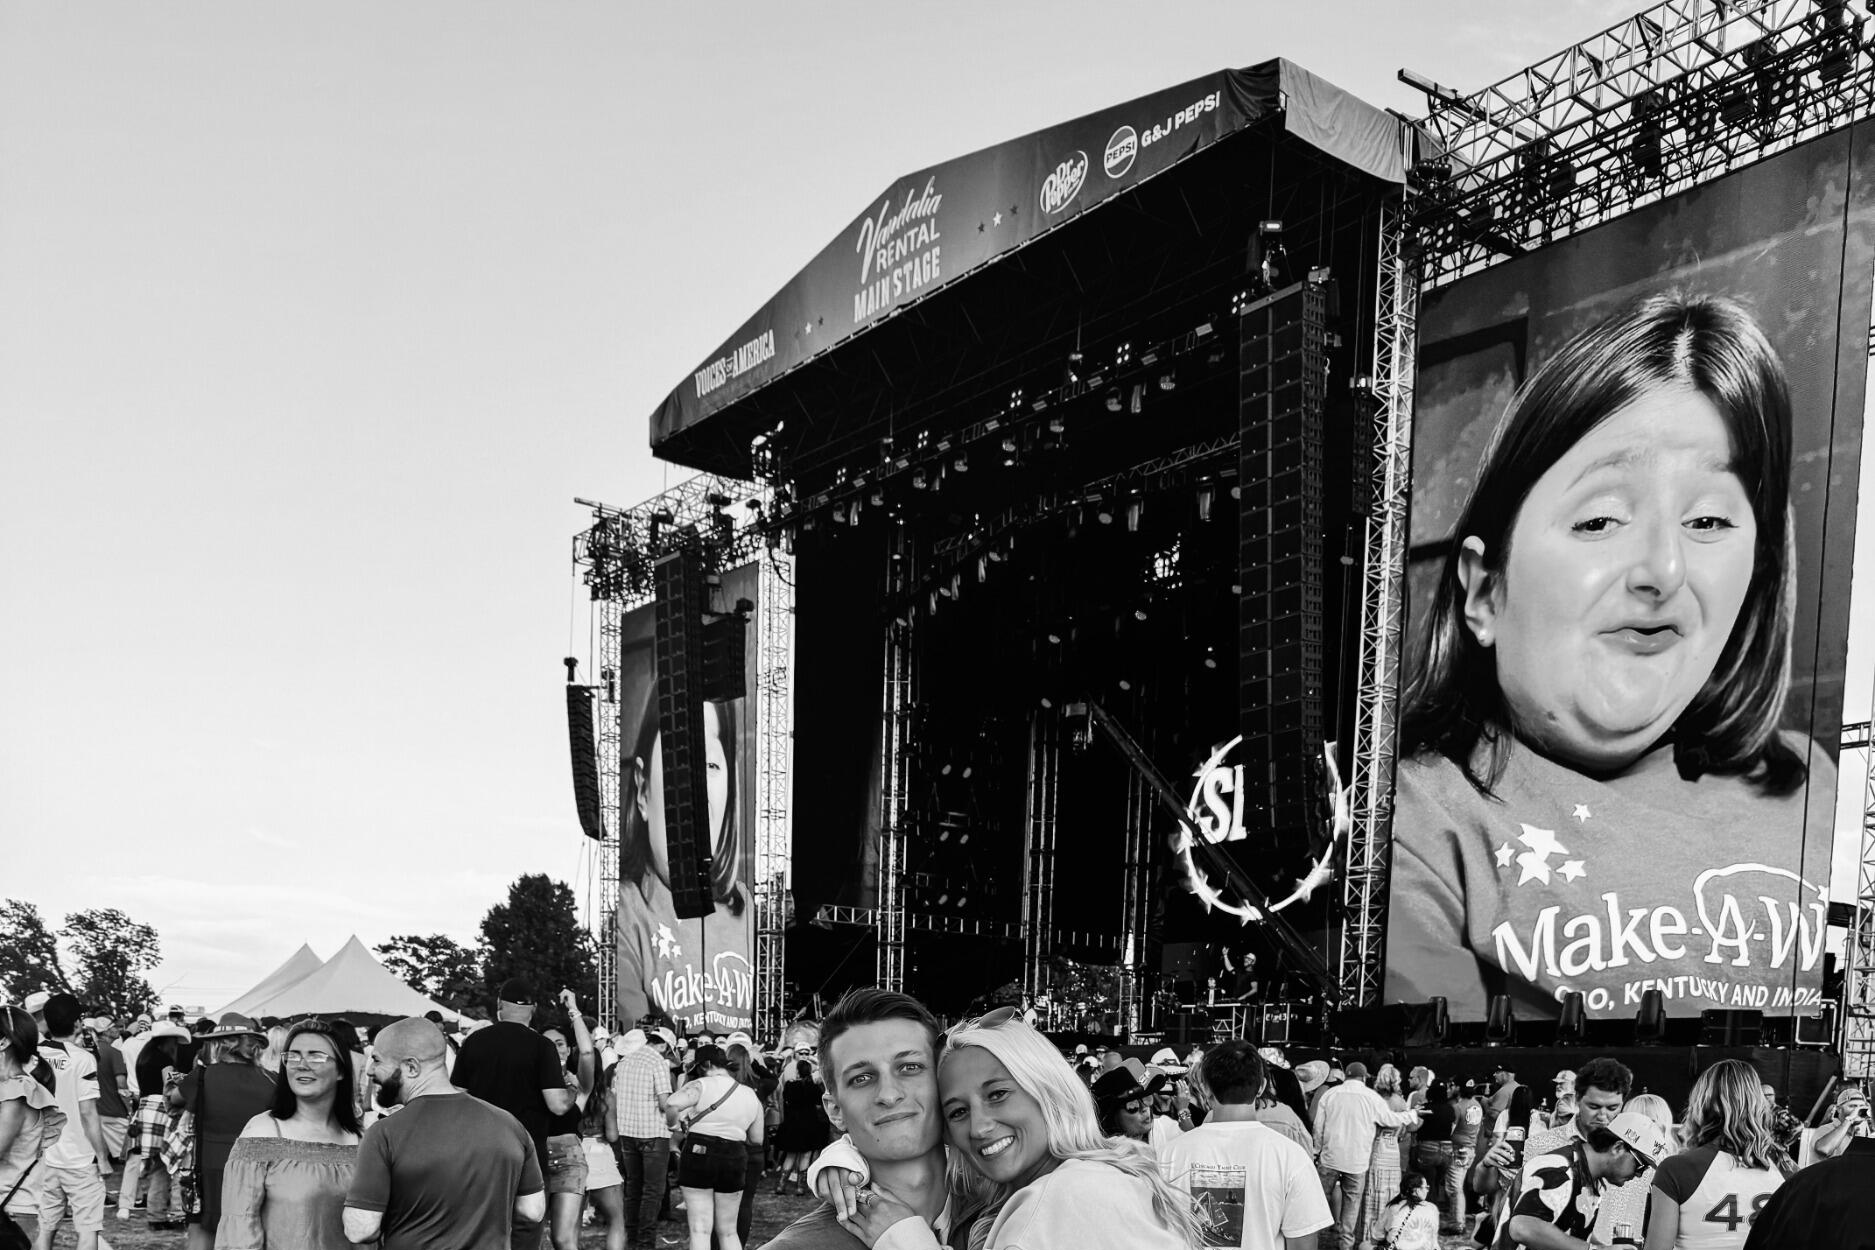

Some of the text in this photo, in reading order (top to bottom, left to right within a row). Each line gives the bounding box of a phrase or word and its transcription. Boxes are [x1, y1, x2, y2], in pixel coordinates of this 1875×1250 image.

[1141, 90, 1221, 147] G&J PEPSI
[1056, 158, 1074, 182] Dr
[1106, 140, 1135, 163] PEPSI
[1042, 160, 1084, 214] Pepper
[856, 175, 942, 285] Vandalia
[877, 218, 941, 273] RENTAL
[854, 246, 941, 323] MAIN STAGE
[695, 357, 727, 398] VOICES
[732, 328, 775, 378] AMERICA
[1554, 986, 1615, 1011] OO,
[1731, 984, 1769, 1007] AND
